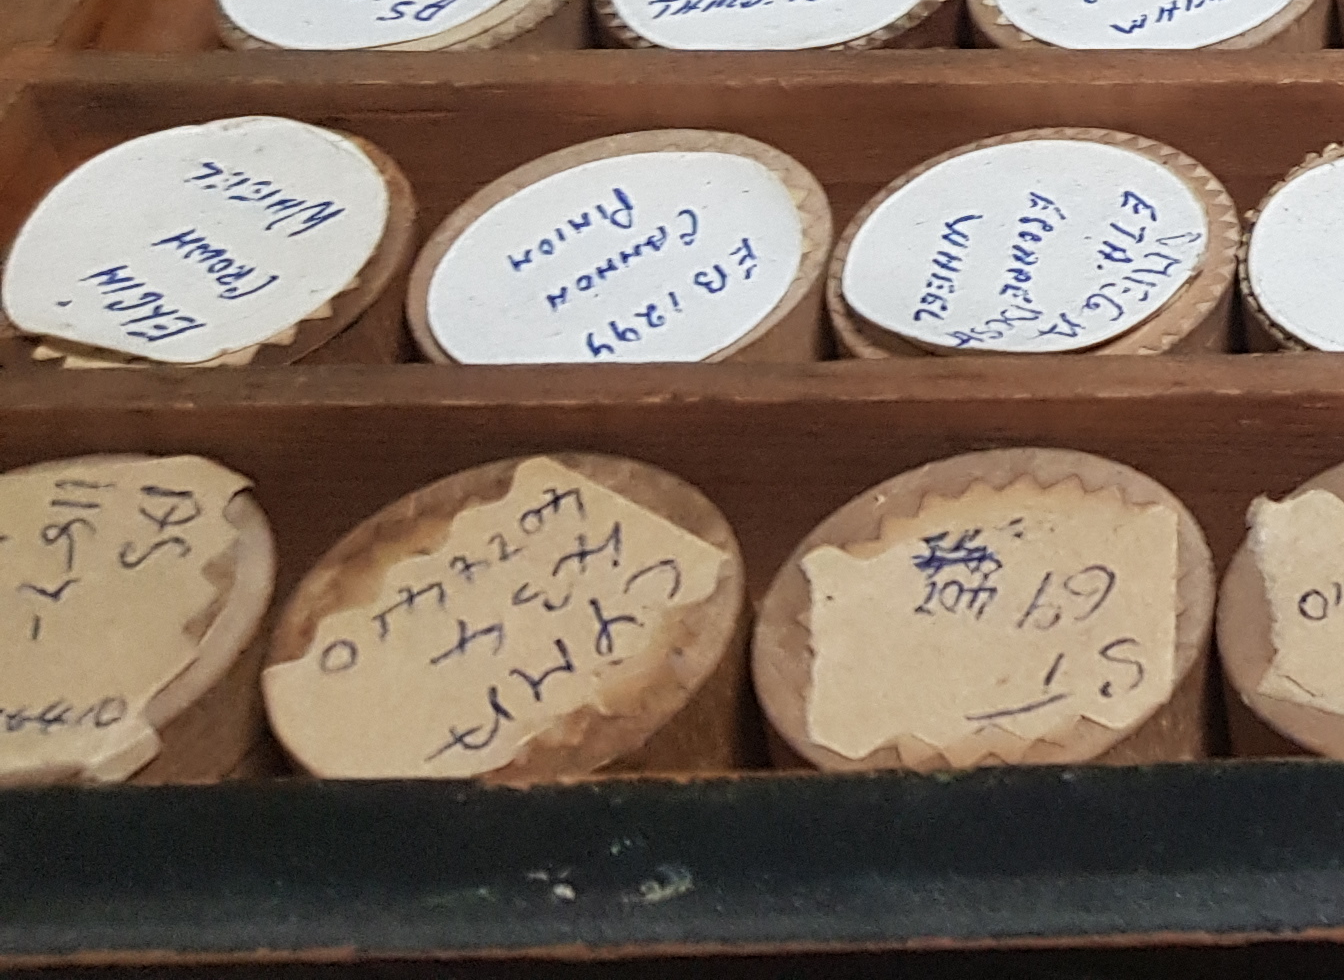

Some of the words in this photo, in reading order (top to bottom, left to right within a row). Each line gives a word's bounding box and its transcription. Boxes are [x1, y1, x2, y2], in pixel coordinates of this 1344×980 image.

[150, 229, 280, 301] CROWN
[508, 187, 636, 272] PINION
[545, 208, 699, 311] CANNON
